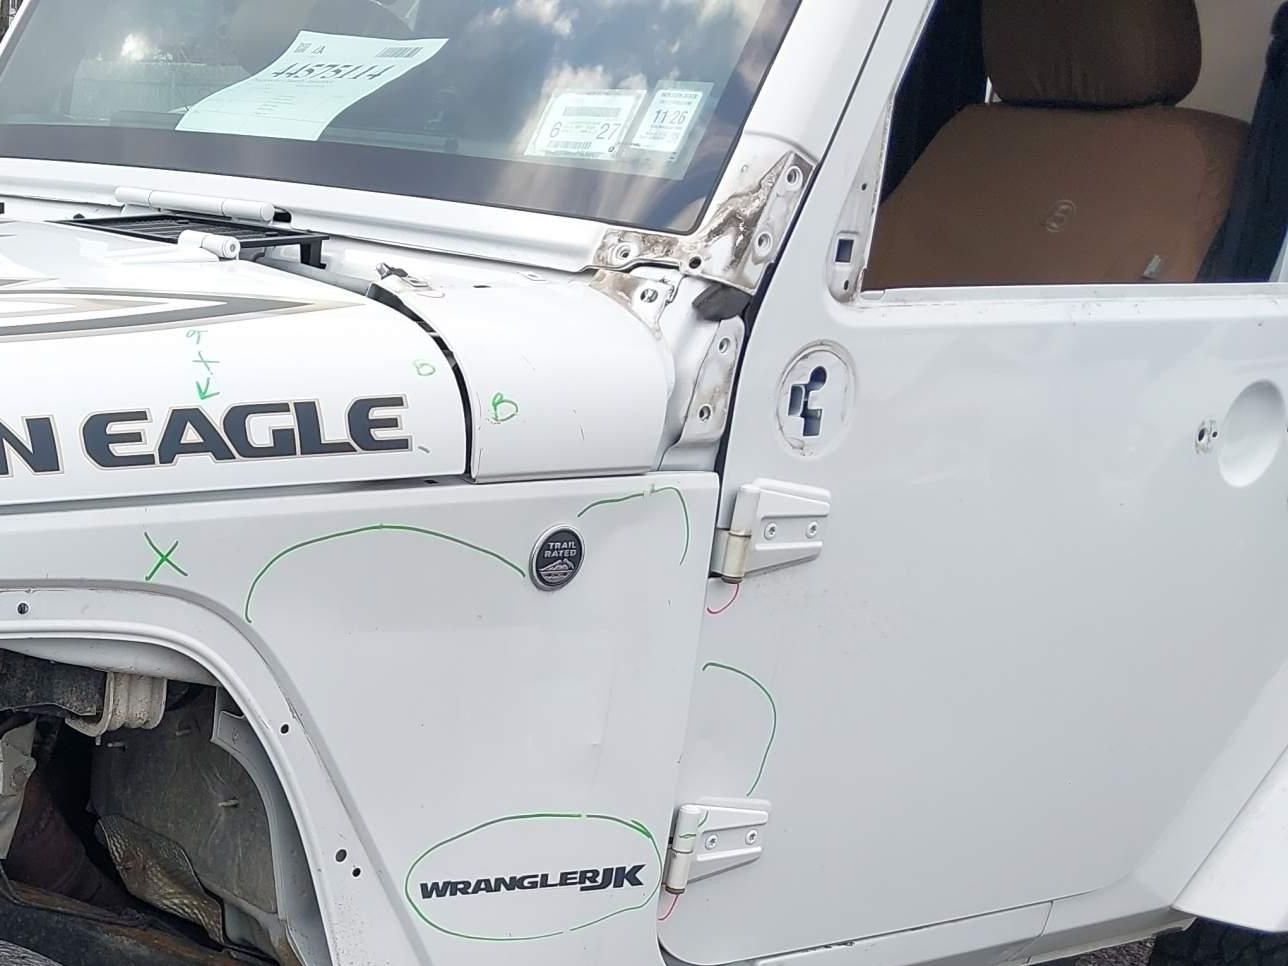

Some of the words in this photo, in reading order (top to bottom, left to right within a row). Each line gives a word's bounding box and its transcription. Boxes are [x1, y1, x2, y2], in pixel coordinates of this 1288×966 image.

[272, 62, 396, 81] 44575114
[550, 121, 563, 138] 6
[596, 122, 622, 140] 27
[83, 395, 413, 469] EAGLE
[544, 549, 577, 558] RATED
[548, 541, 577, 550] TRAIL
